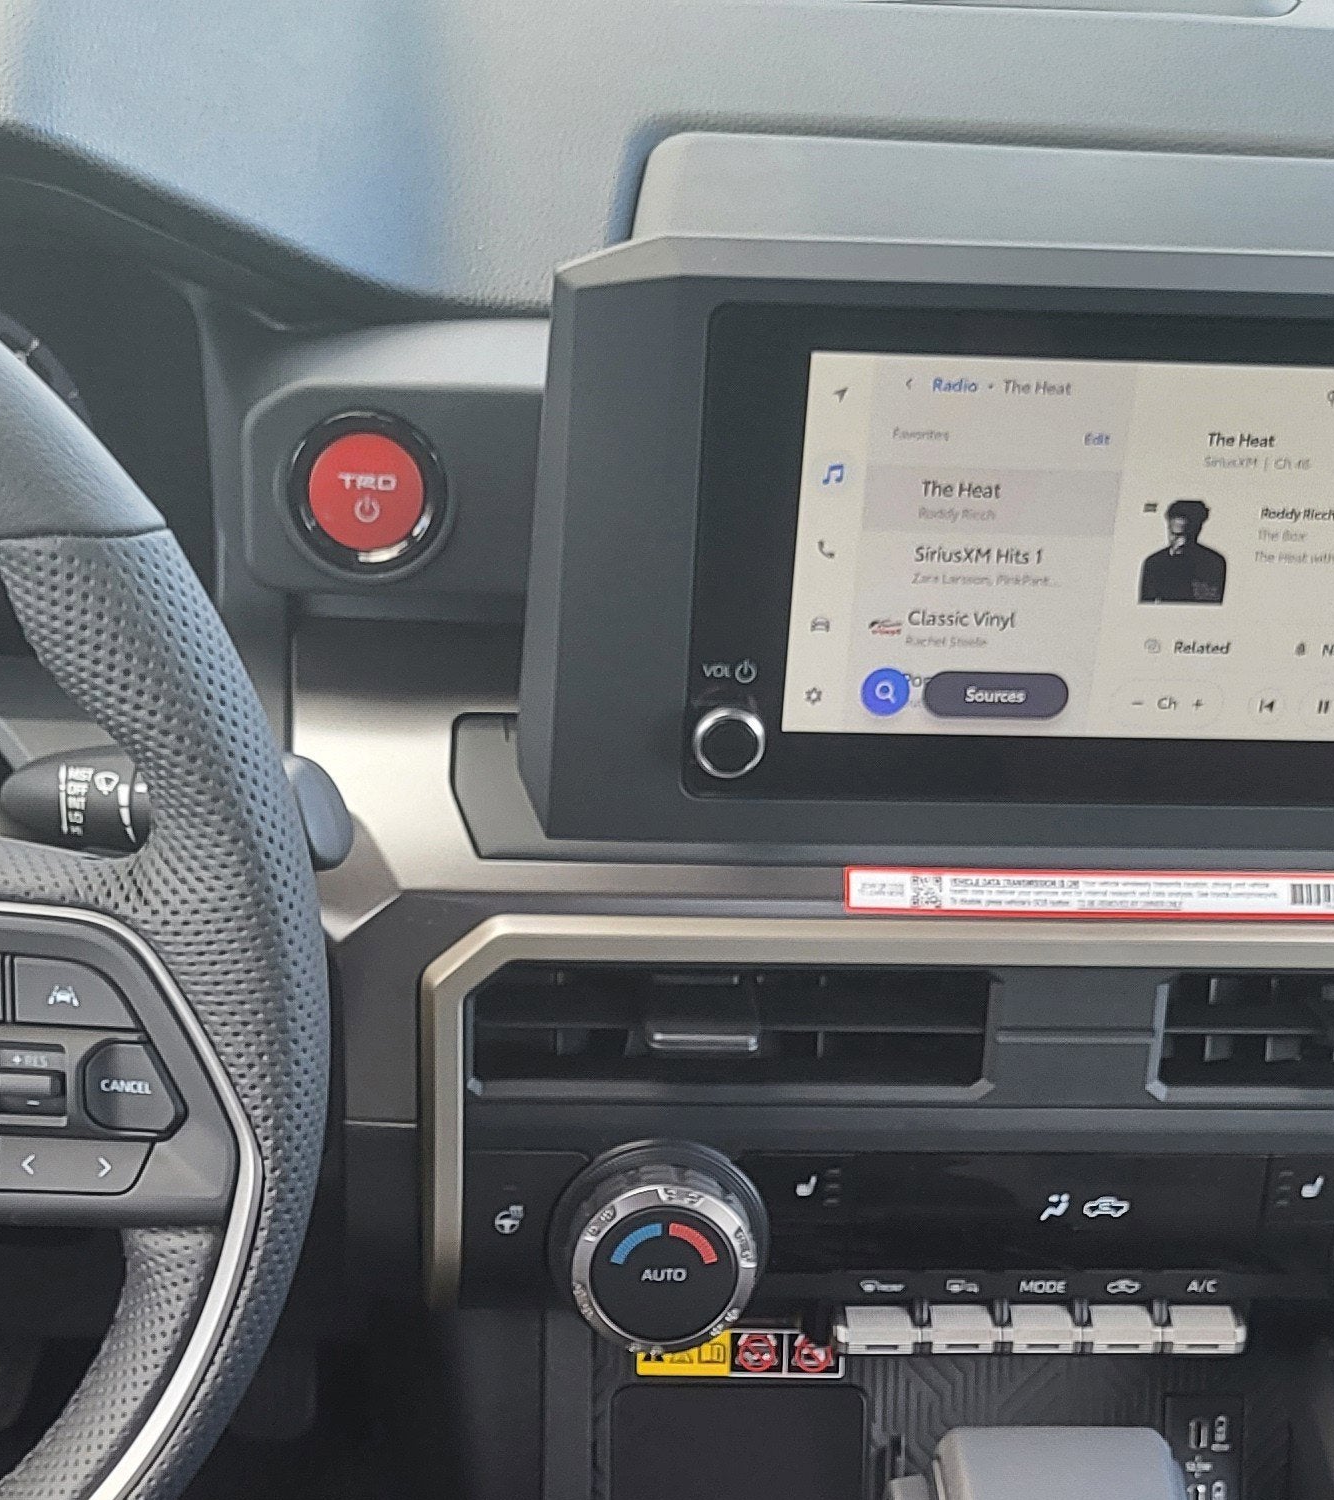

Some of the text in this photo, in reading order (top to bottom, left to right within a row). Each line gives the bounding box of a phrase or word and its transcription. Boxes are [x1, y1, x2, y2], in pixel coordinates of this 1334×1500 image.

[931, 376, 978, 394] Radio
[1003, 379, 1073, 396] The Heat
[1083, 432, 1112, 447] Edit
[1207, 431, 1277, 449] The Heat
[337, 471, 398, 491] TRD
[921, 480, 1002, 500] The Heat
[1260, 507, 1303, 524] Roddy
[913, 545, 1044, 566] SiriusXM Hits 1
[907, 609, 970, 628] Classic
[972, 610, 1018, 632] Vinyl
[1173, 640, 1232, 656] Related
[701, 662, 732, 678] VOL
[964, 687, 1028, 705] Sources
[1156, 696, 1178, 711] Ch
[99, 1078, 152, 1096] CANCEL
[641, 1267, 688, 1283] AUTO
[1018, 1278, 1068, 1294] MODE
[1186, 1278, 1219, 1294] A/C
